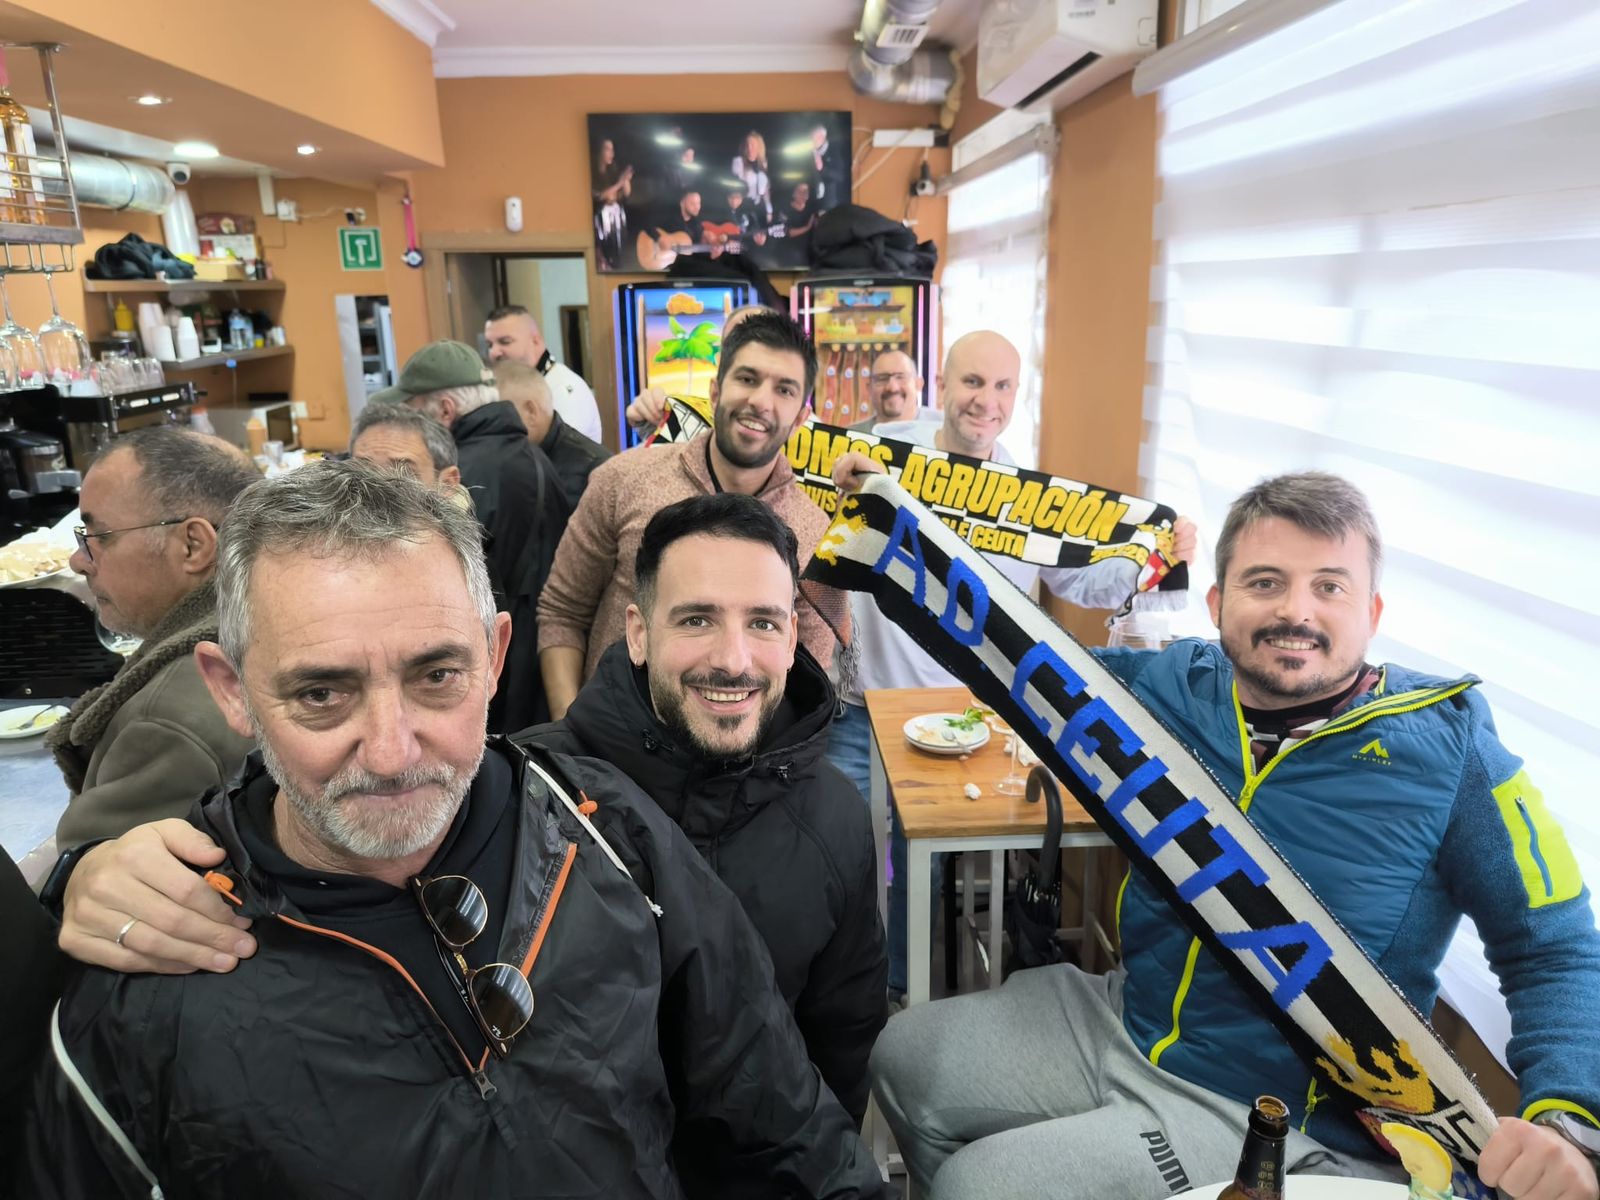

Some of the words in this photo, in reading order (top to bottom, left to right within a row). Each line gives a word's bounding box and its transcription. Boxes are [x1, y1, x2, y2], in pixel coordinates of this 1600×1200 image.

[900, 453, 1129, 542] AGRUPACIÓN
[971, 524, 1026, 557] CEUTA
[1009, 640, 1334, 1011] CEUTA
[1139, 1130, 1194, 1195] PUM
